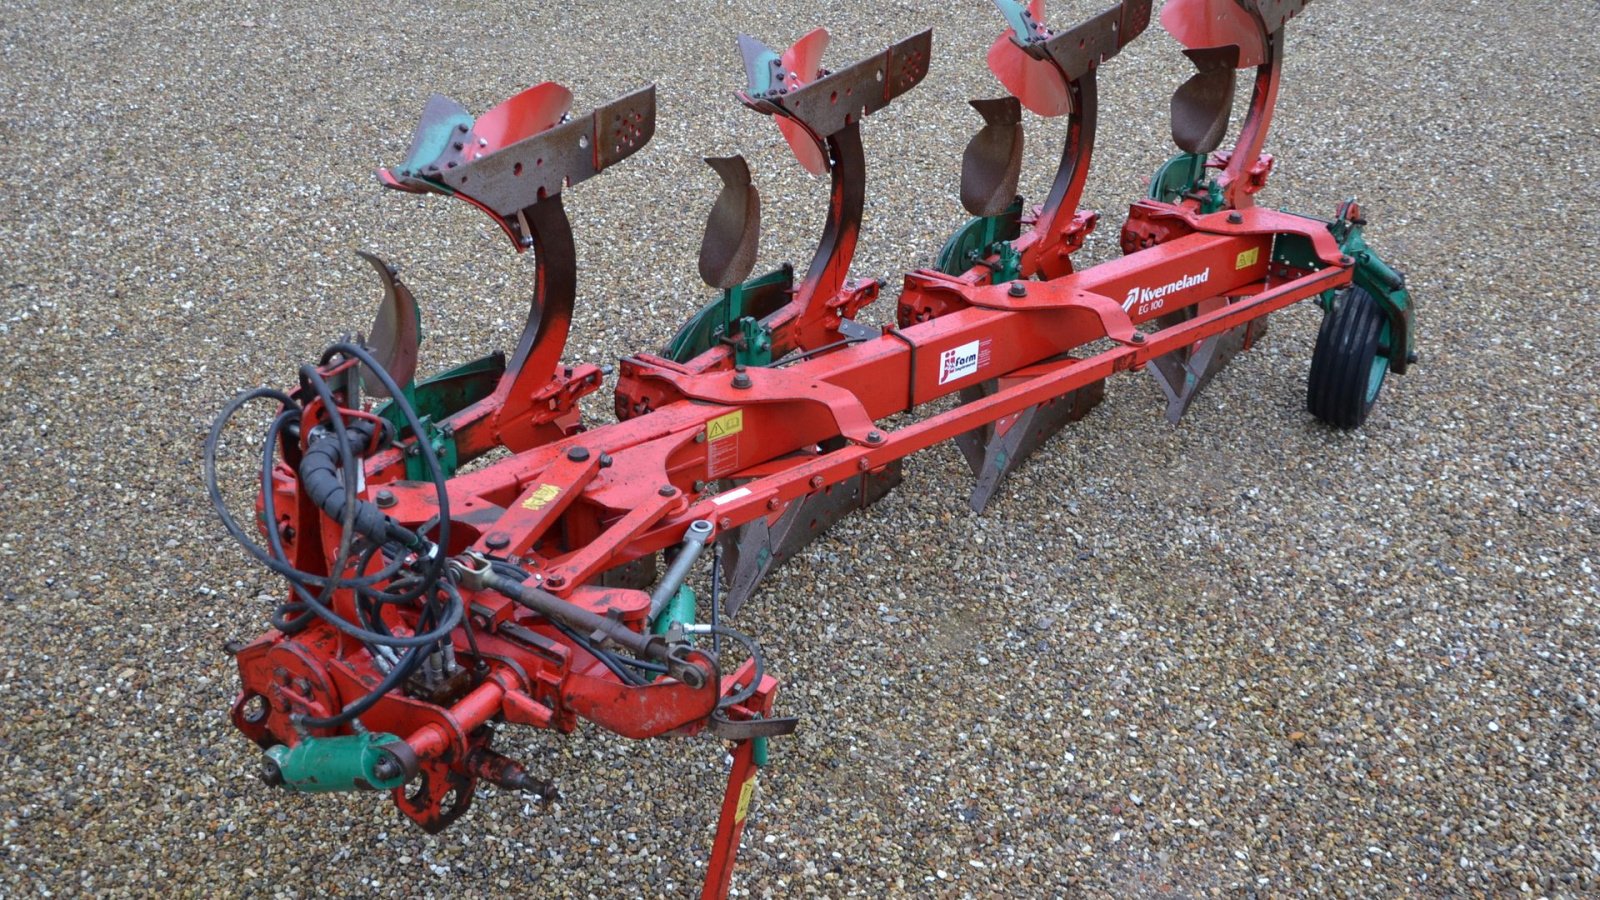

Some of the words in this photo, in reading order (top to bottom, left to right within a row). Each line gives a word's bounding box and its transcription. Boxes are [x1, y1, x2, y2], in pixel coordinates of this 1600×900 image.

[1140, 267, 1209, 303] Kverneland
[1138, 303, 1149, 315] EG
[1150, 299, 1164, 311] 100
[955, 354, 976, 367] farm
